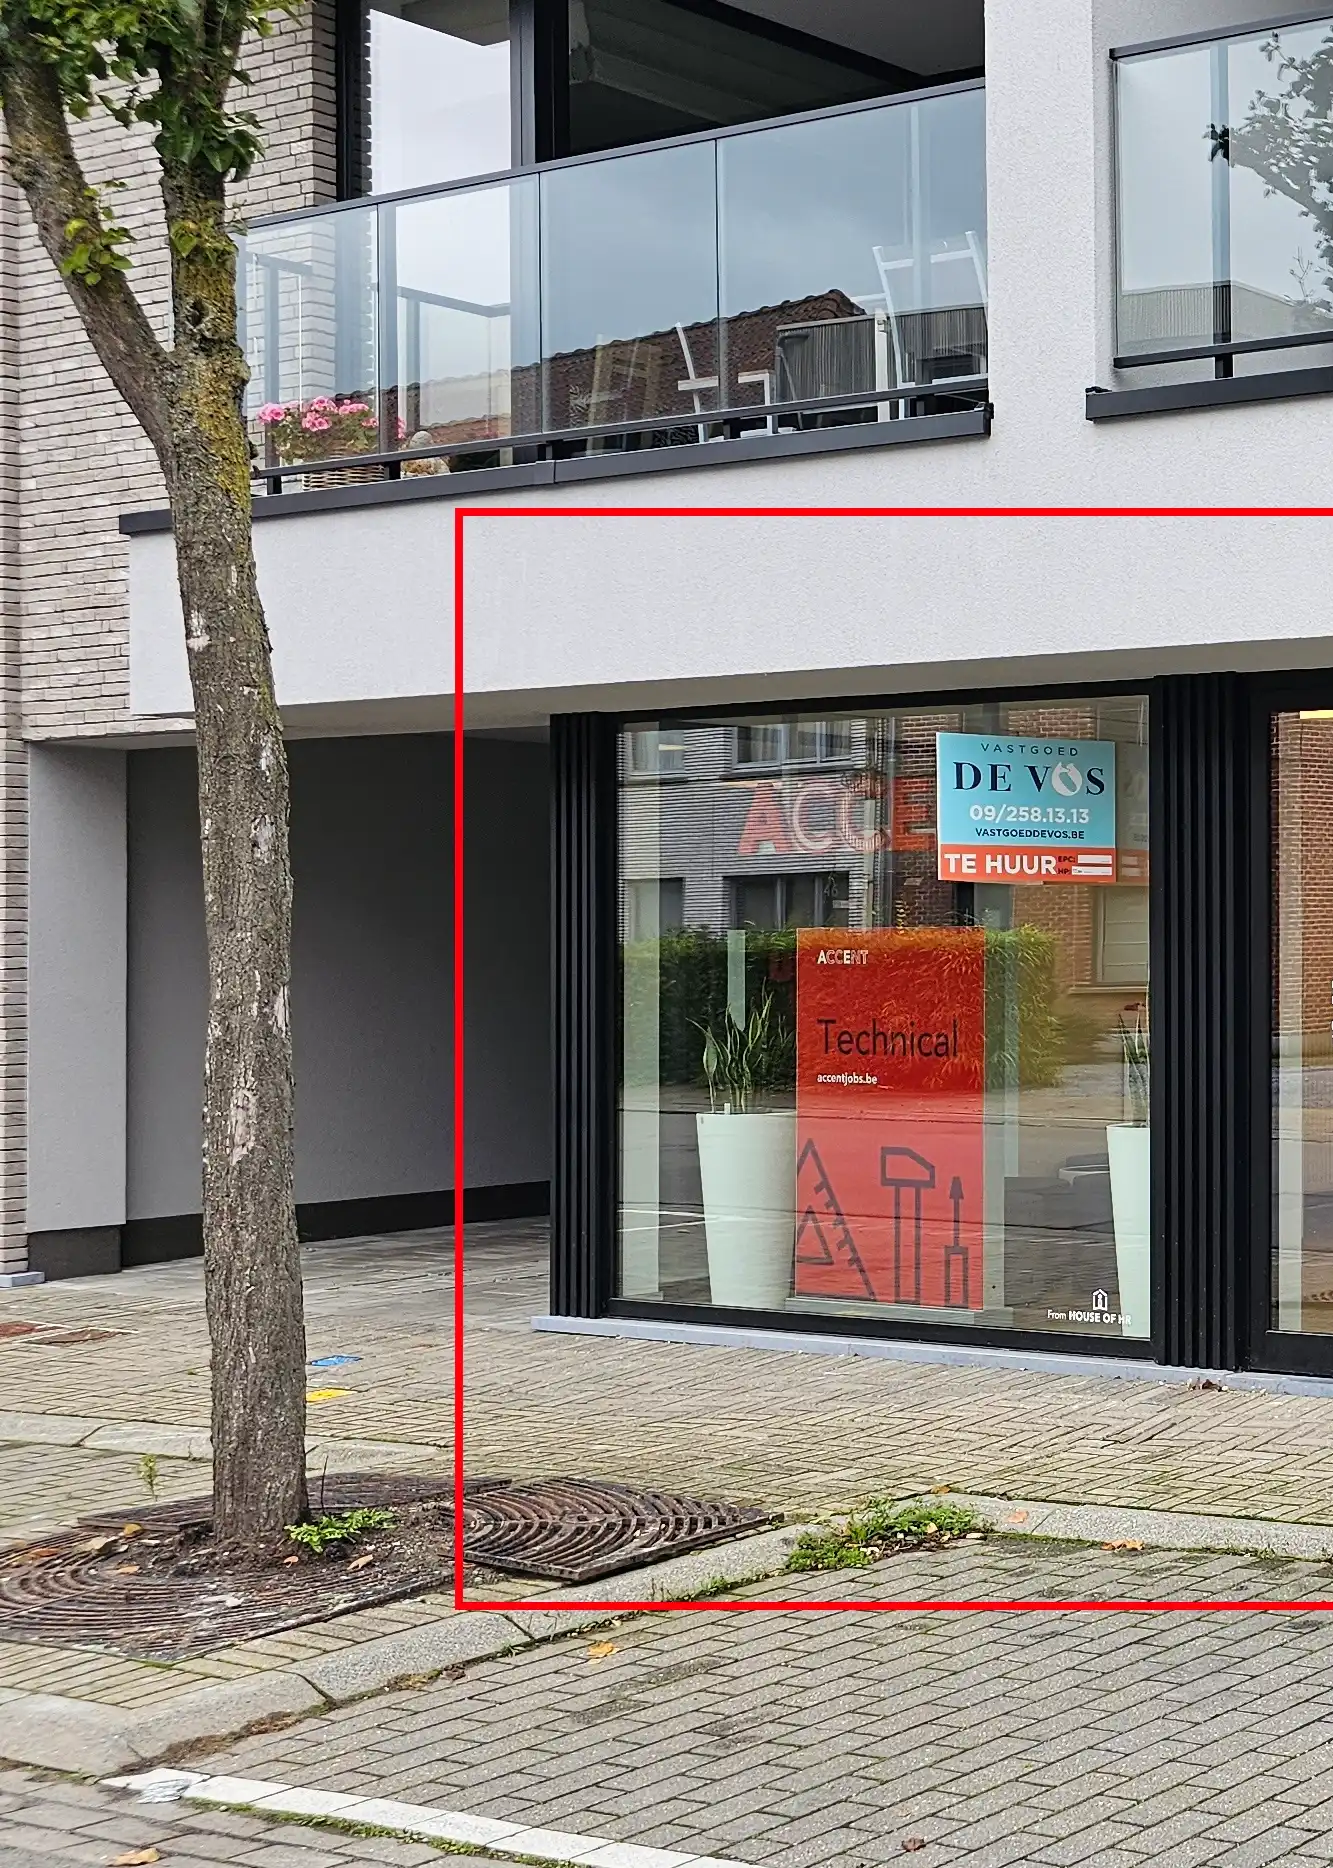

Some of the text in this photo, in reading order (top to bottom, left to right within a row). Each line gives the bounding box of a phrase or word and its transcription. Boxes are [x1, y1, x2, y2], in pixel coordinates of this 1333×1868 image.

[980, 742, 1079, 757] VASTGOED
[952, 761, 1106, 797] DE VOS
[737, 776, 937, 856] ACCE
[969, 803, 1090, 825] 09/258.13.13
[975, 827, 1086, 840] VASTGOEDDEVOS.BE
[944, 853, 1057, 876] TE HUUR
[816, 949, 869, 965] ACCENT
[816, 1017, 960, 1058] Technical
[817, 1072, 878, 1087] accentjobs.be
[1047, 1309, 1132, 1326] From HOUSE OF HR
